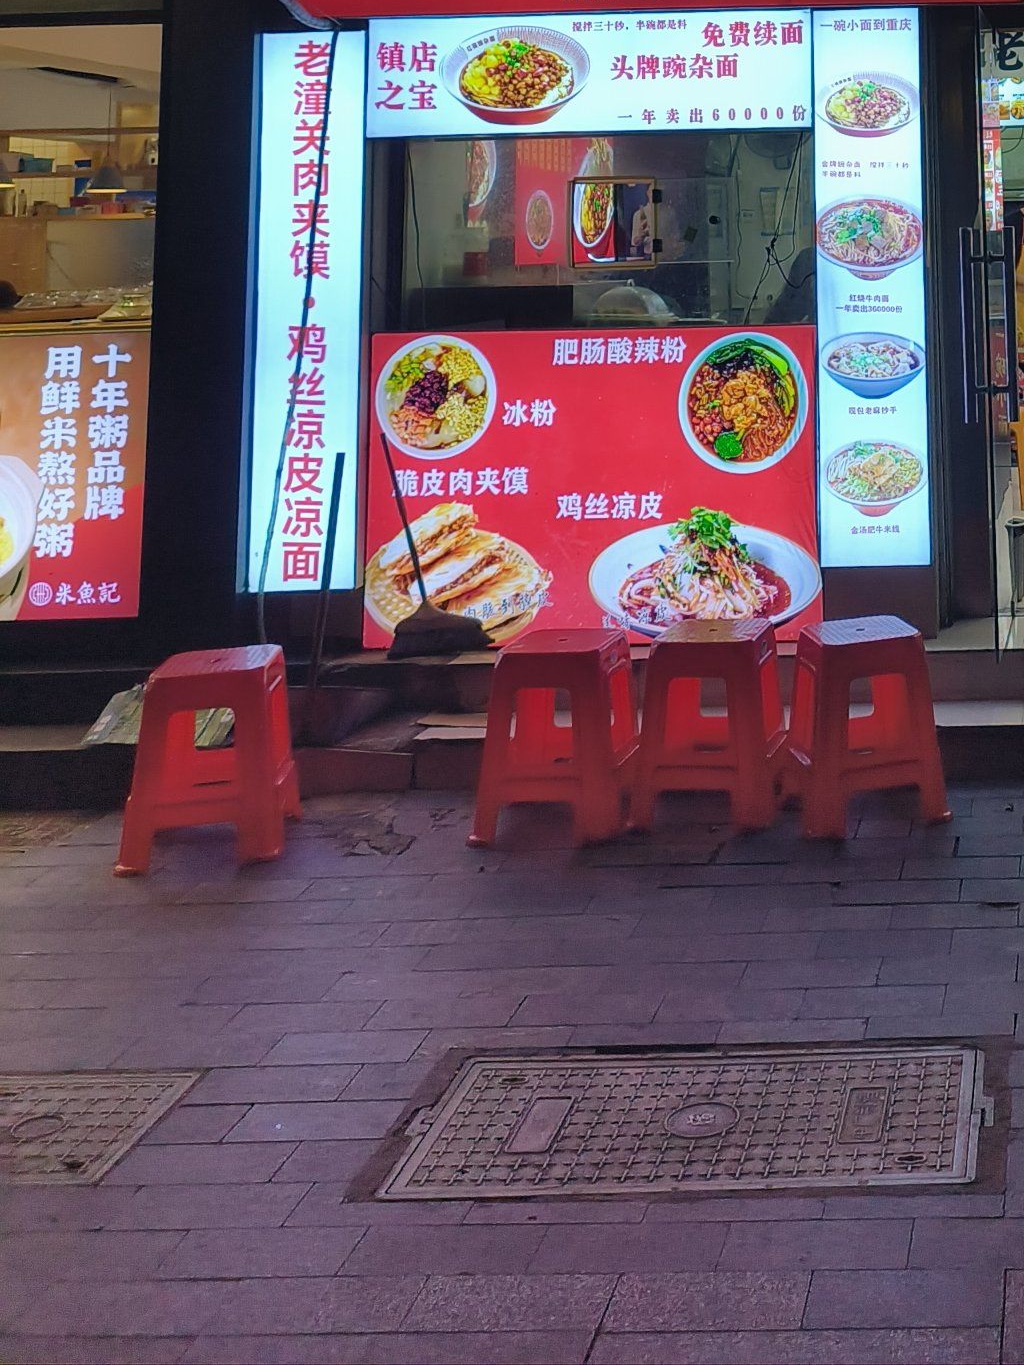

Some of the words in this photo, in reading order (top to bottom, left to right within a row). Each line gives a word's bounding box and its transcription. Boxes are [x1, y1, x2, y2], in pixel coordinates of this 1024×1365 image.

[701, 18, 805, 48] 免费续面
[819, 17, 912, 32] 一碗小面到重庆
[376, 41, 438, 74] 镇店
[610, 52, 739, 81] 头牌豌杂面
[374, 79, 439, 111] 之宝
[617, 104, 808, 125] 一年卖出60000份
[552, 335, 687, 366] 肥肠酸辣粉
[502, 398, 557, 428] 冰粉
[84, 344, 132, 521] 十年粥品牌
[556, 491, 664, 522] 鸡丝凉皮
